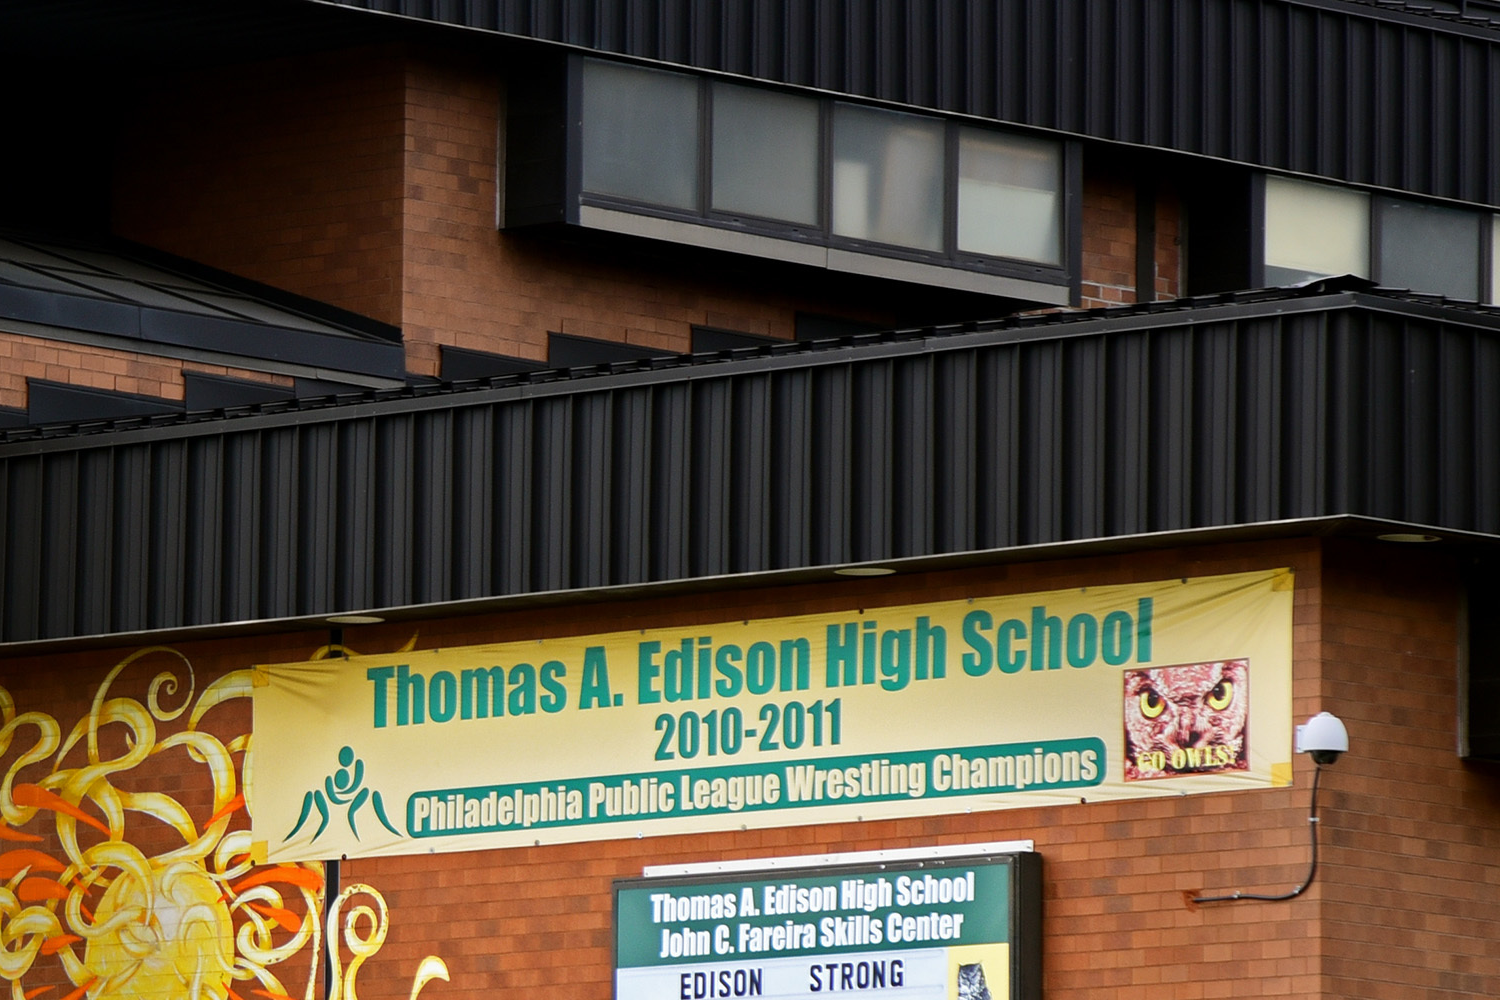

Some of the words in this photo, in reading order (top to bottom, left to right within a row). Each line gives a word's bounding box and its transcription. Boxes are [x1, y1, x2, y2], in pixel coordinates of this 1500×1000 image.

[367, 660, 568, 728] Thomas
[579, 646, 624, 709] A.
[637, 636, 811, 705] Edison
[825, 616, 947, 692] High
[961, 596, 1154, 677] School
[654, 697, 842, 761] 2010-2011
[1137, 751, 1166, 771] GO
[1171, 744, 1236, 770] OWLS!
[414, 785, 582, 831] Philadelphia
[589, 775, 674, 818] Public
[681, 769, 780, 813] League
[786, 760, 926, 801] Wrestling
[933, 747, 1099, 792] Champions
[650, 893, 737, 923] Thomas
[739, 887, 760, 917] A.
[764, 882, 838, 915] Edison
[840, 877, 893, 911] High
[896, 871, 975, 906] School
[660, 927, 711, 958] John
[714, 924, 735, 955] C.
[738, 920, 817, 952] Fareira
[819, 914, 884, 948] Skills
[886, 912, 964, 943] Center
[680, 968, 763, 1000] EDISON
[809, 959, 905, 992] STRONG
